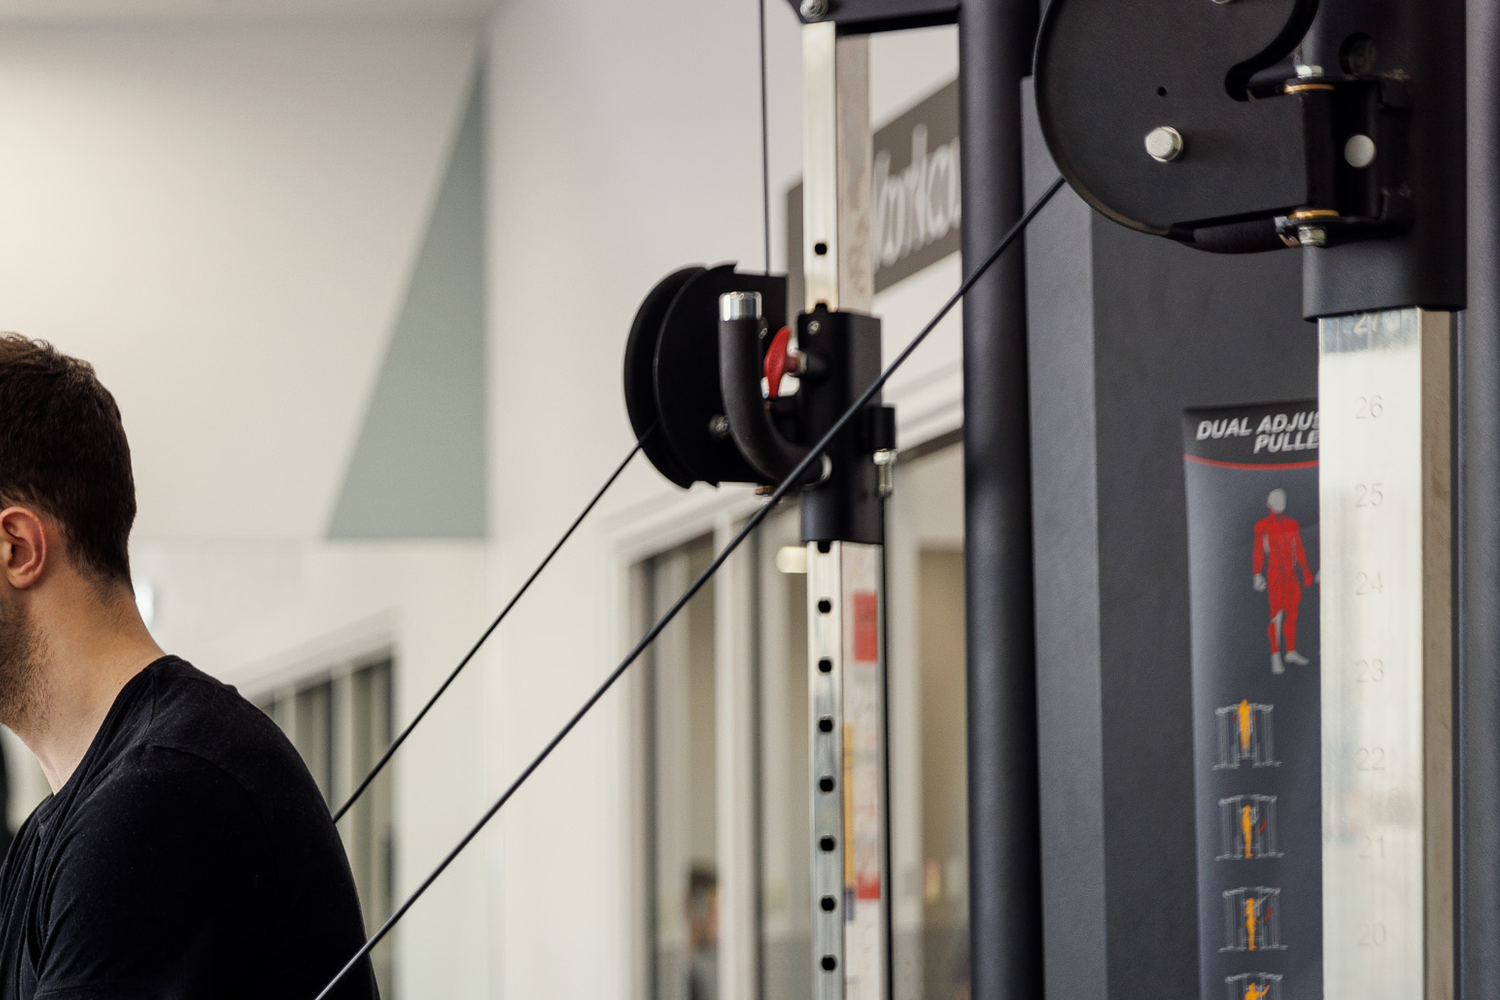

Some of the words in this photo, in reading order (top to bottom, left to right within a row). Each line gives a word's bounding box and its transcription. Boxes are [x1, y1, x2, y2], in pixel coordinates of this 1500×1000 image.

[1355, 395, 1384, 420] 26
[1196, 416, 1252, 441] DUAL
[1354, 483, 1384, 508] 25
[1355, 571, 1384, 596] 24
[1356, 659, 1385, 683] 23
[1357, 747, 1386, 772] 22
[1358, 835, 1386, 860] 21
[1358, 923, 1387, 948] 20
